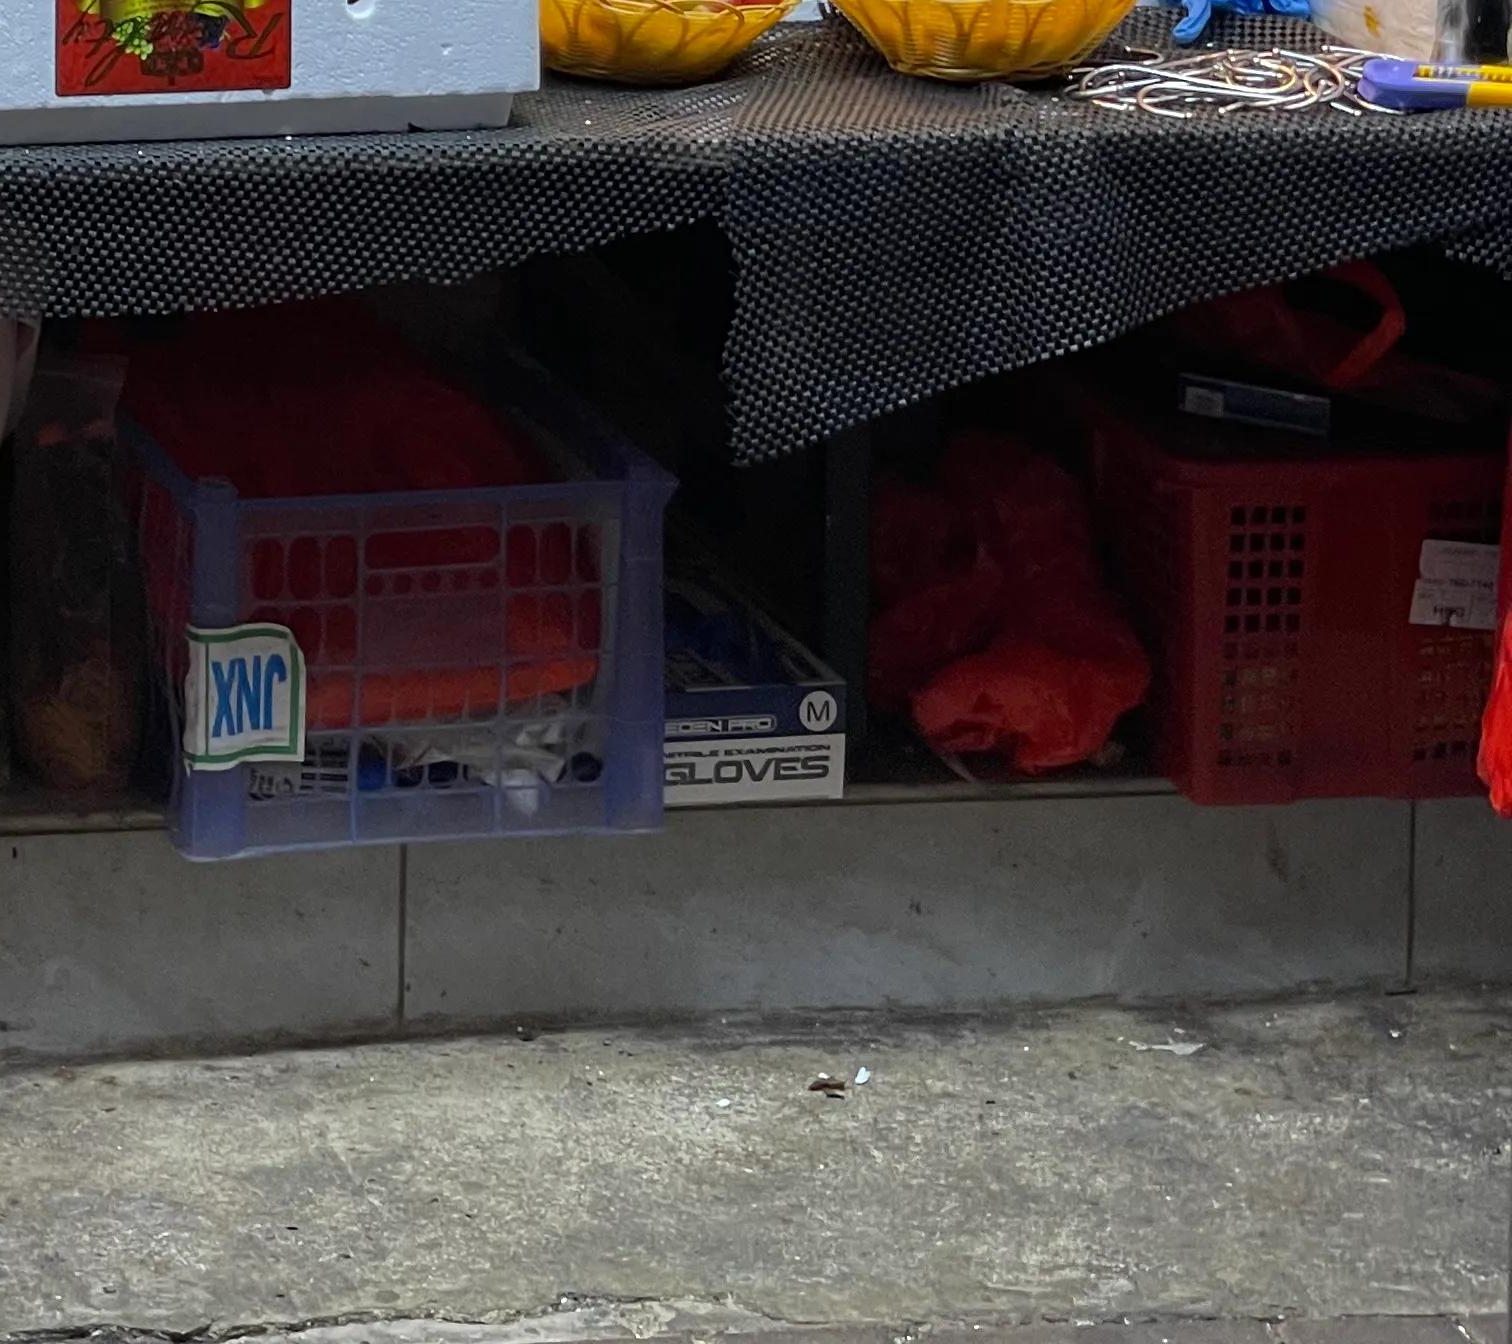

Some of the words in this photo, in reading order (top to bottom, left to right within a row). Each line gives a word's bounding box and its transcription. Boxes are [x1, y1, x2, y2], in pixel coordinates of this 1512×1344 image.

[806, 700, 830, 723] M
[724, 744, 831, 757] EXAMINATION
[665, 755, 831, 786] GLOVES
